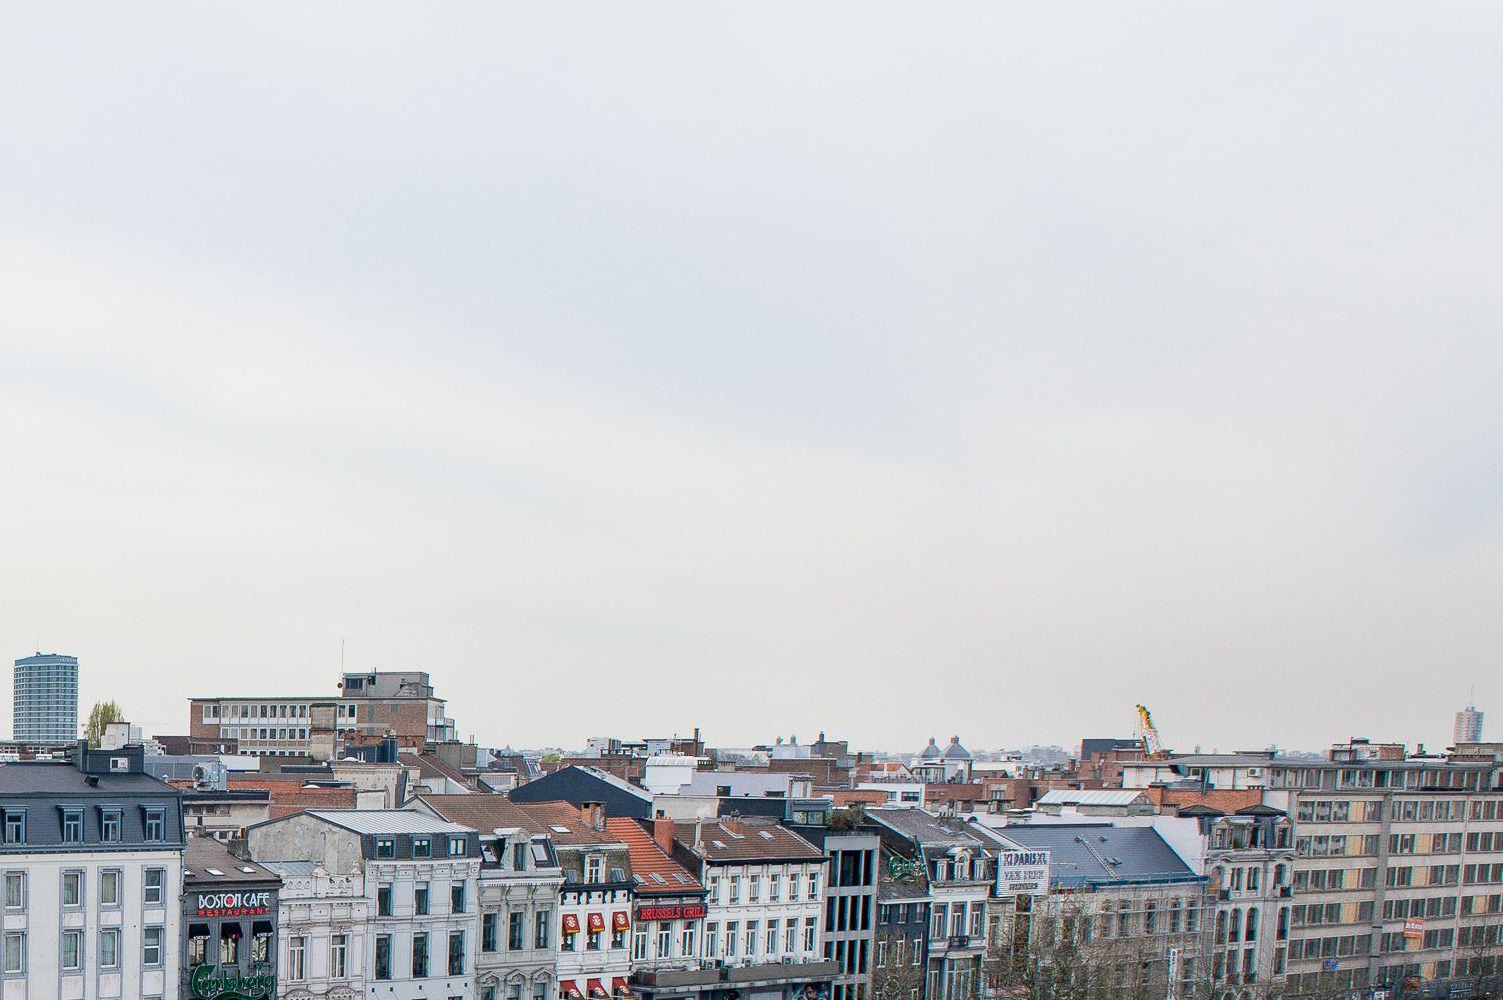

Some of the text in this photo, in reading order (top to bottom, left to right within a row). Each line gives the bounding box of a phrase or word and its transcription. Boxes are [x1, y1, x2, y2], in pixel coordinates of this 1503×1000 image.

[1014, 853, 1037, 866] PARIS
[1037, 852, 1047, 865] XL
[198, 892, 270, 909] BOSTON CAFE
[198, 907, 270, 917] RESTAURANT
[640, 906, 707, 920] BRUSSELS GRILL
